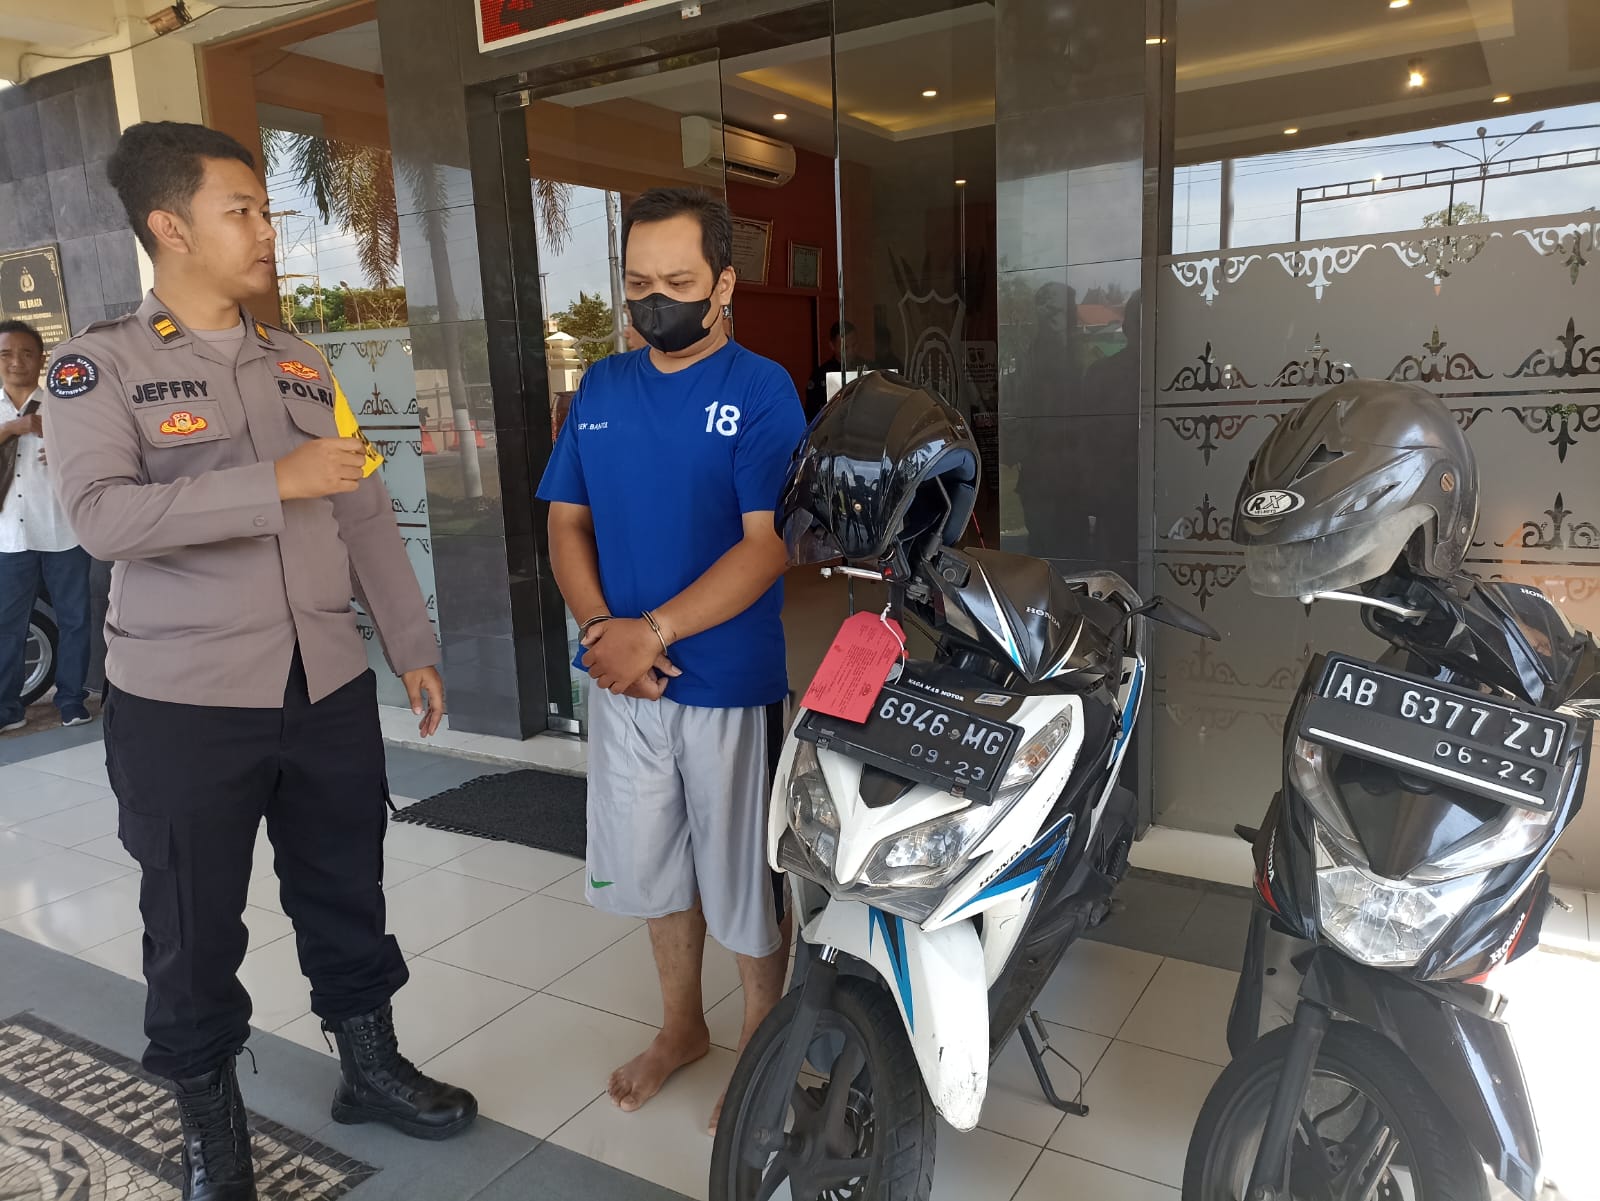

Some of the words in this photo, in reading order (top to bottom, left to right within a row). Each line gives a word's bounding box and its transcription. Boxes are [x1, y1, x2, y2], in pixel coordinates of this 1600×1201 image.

[132, 380, 208, 404] JEFFRY
[277, 380, 334, 408] POLRI
[704, 401, 741, 437] 18
[1249, 494, 1288, 511] RX
[1026, 606, 1061, 629] HONDA
[940, 690, 965, 702] MOTOR
[1334, 673, 1378, 706] AB
[1400, 690, 1490, 736] 6377
[879, 697, 950, 736] 6946
[961, 723, 1004, 755] MG
[979, 844, 1028, 888] HONDA
[1489, 912, 1526, 965] HONDA
